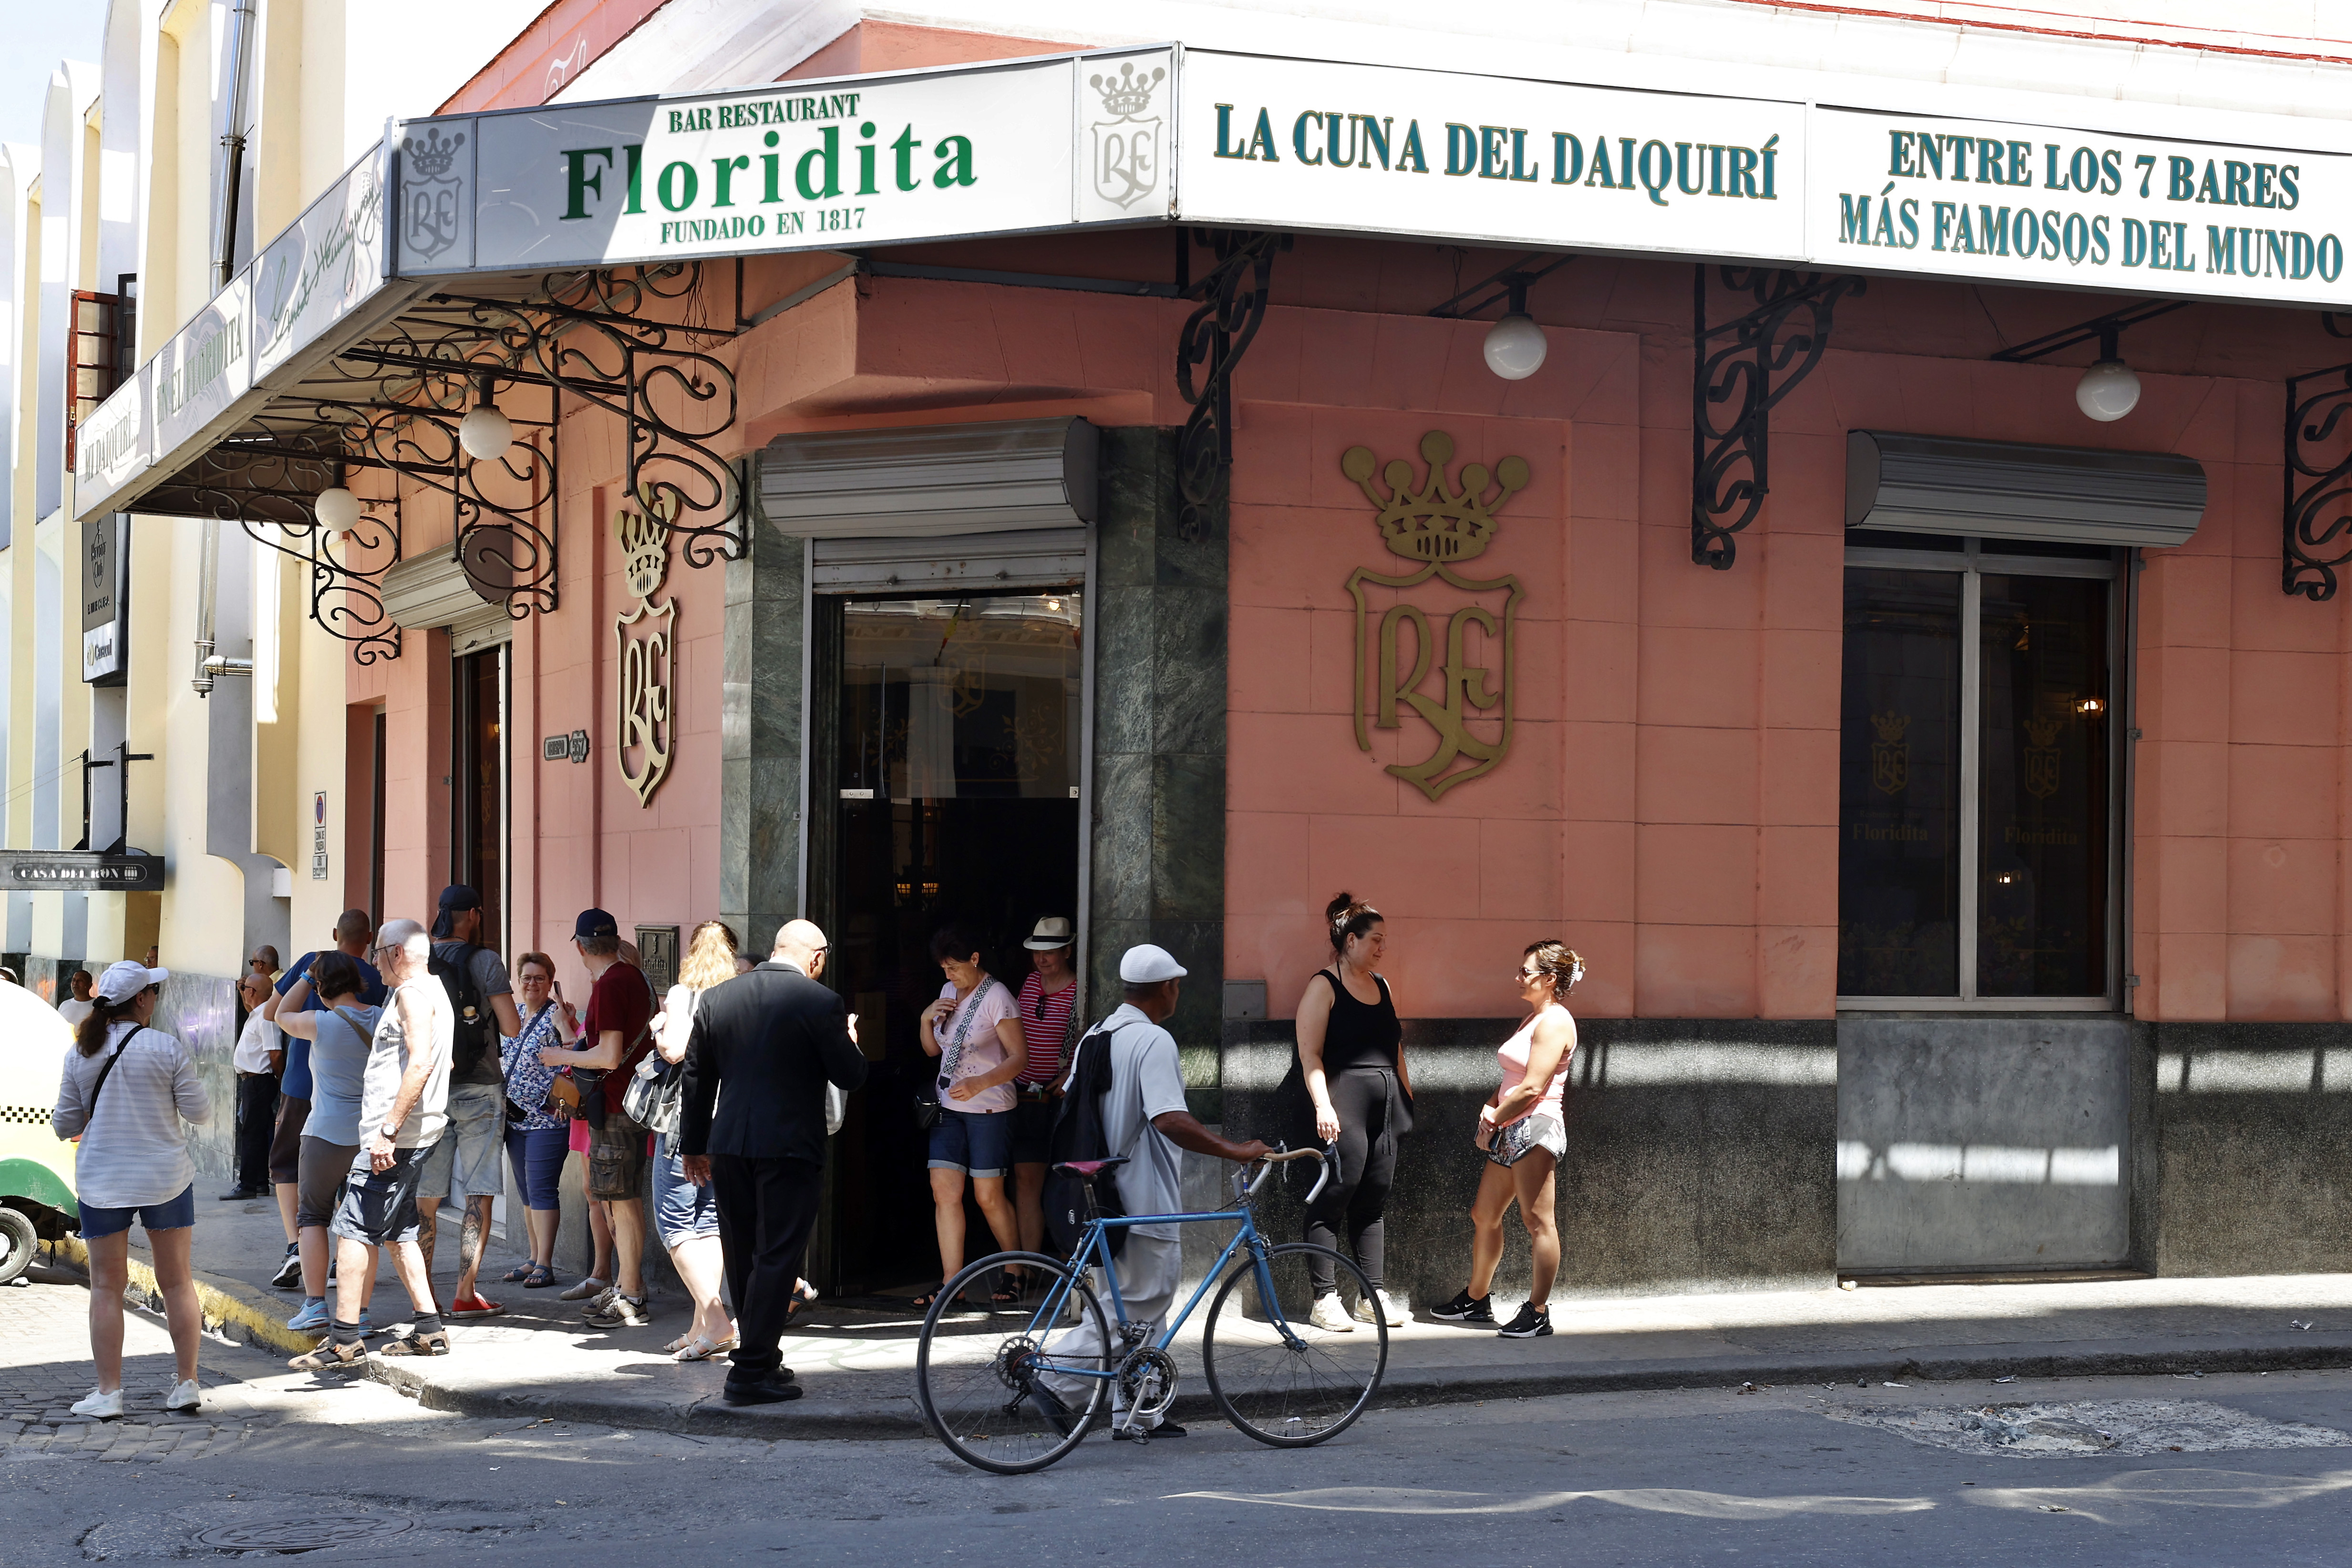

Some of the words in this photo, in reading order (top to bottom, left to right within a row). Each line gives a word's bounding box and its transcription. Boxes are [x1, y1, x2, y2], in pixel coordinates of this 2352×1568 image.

[669, 108, 711, 133] BAR
[719, 93, 860, 130] RESTAURANT
[559, 121, 978, 220] Floridita
[1214, 103, 1279, 162] LA
[1292, 110, 1429, 174] CUNA
[1444, 122, 1538, 183] DEL
[1551, 132, 1779, 206] DAIQUIRÍ
[1888, 129, 2032, 186] ENTRE
[2045, 144, 2121, 195] LOS
[2135, 155, 2156, 198] 7
[2167, 155, 2300, 210] BARES
[661, 214, 765, 244] FUNDADO
[777, 211, 805, 236] EN
[818, 207, 866, 231] 1817
[1839, 181, 1919, 249] MÁS
[1931, 201, 2110, 265] FAMOSOS
[2122, 217, 2195, 271] DEL
[2206, 225, 2343, 283] MUNDO
[171, 368, 183, 415] EL
[186, 313, 242, 403] FLORIDITA
[84, 443, 94, 484] MI
[1853, 823, 1928, 841] Floridita
[2005, 826, 2077, 845] Floridita
[21, 868, 56, 878] CASA
[61, 868, 86, 878] DEL
[91, 868, 119, 878] RON
[644, 959, 667, 970] Floridita
